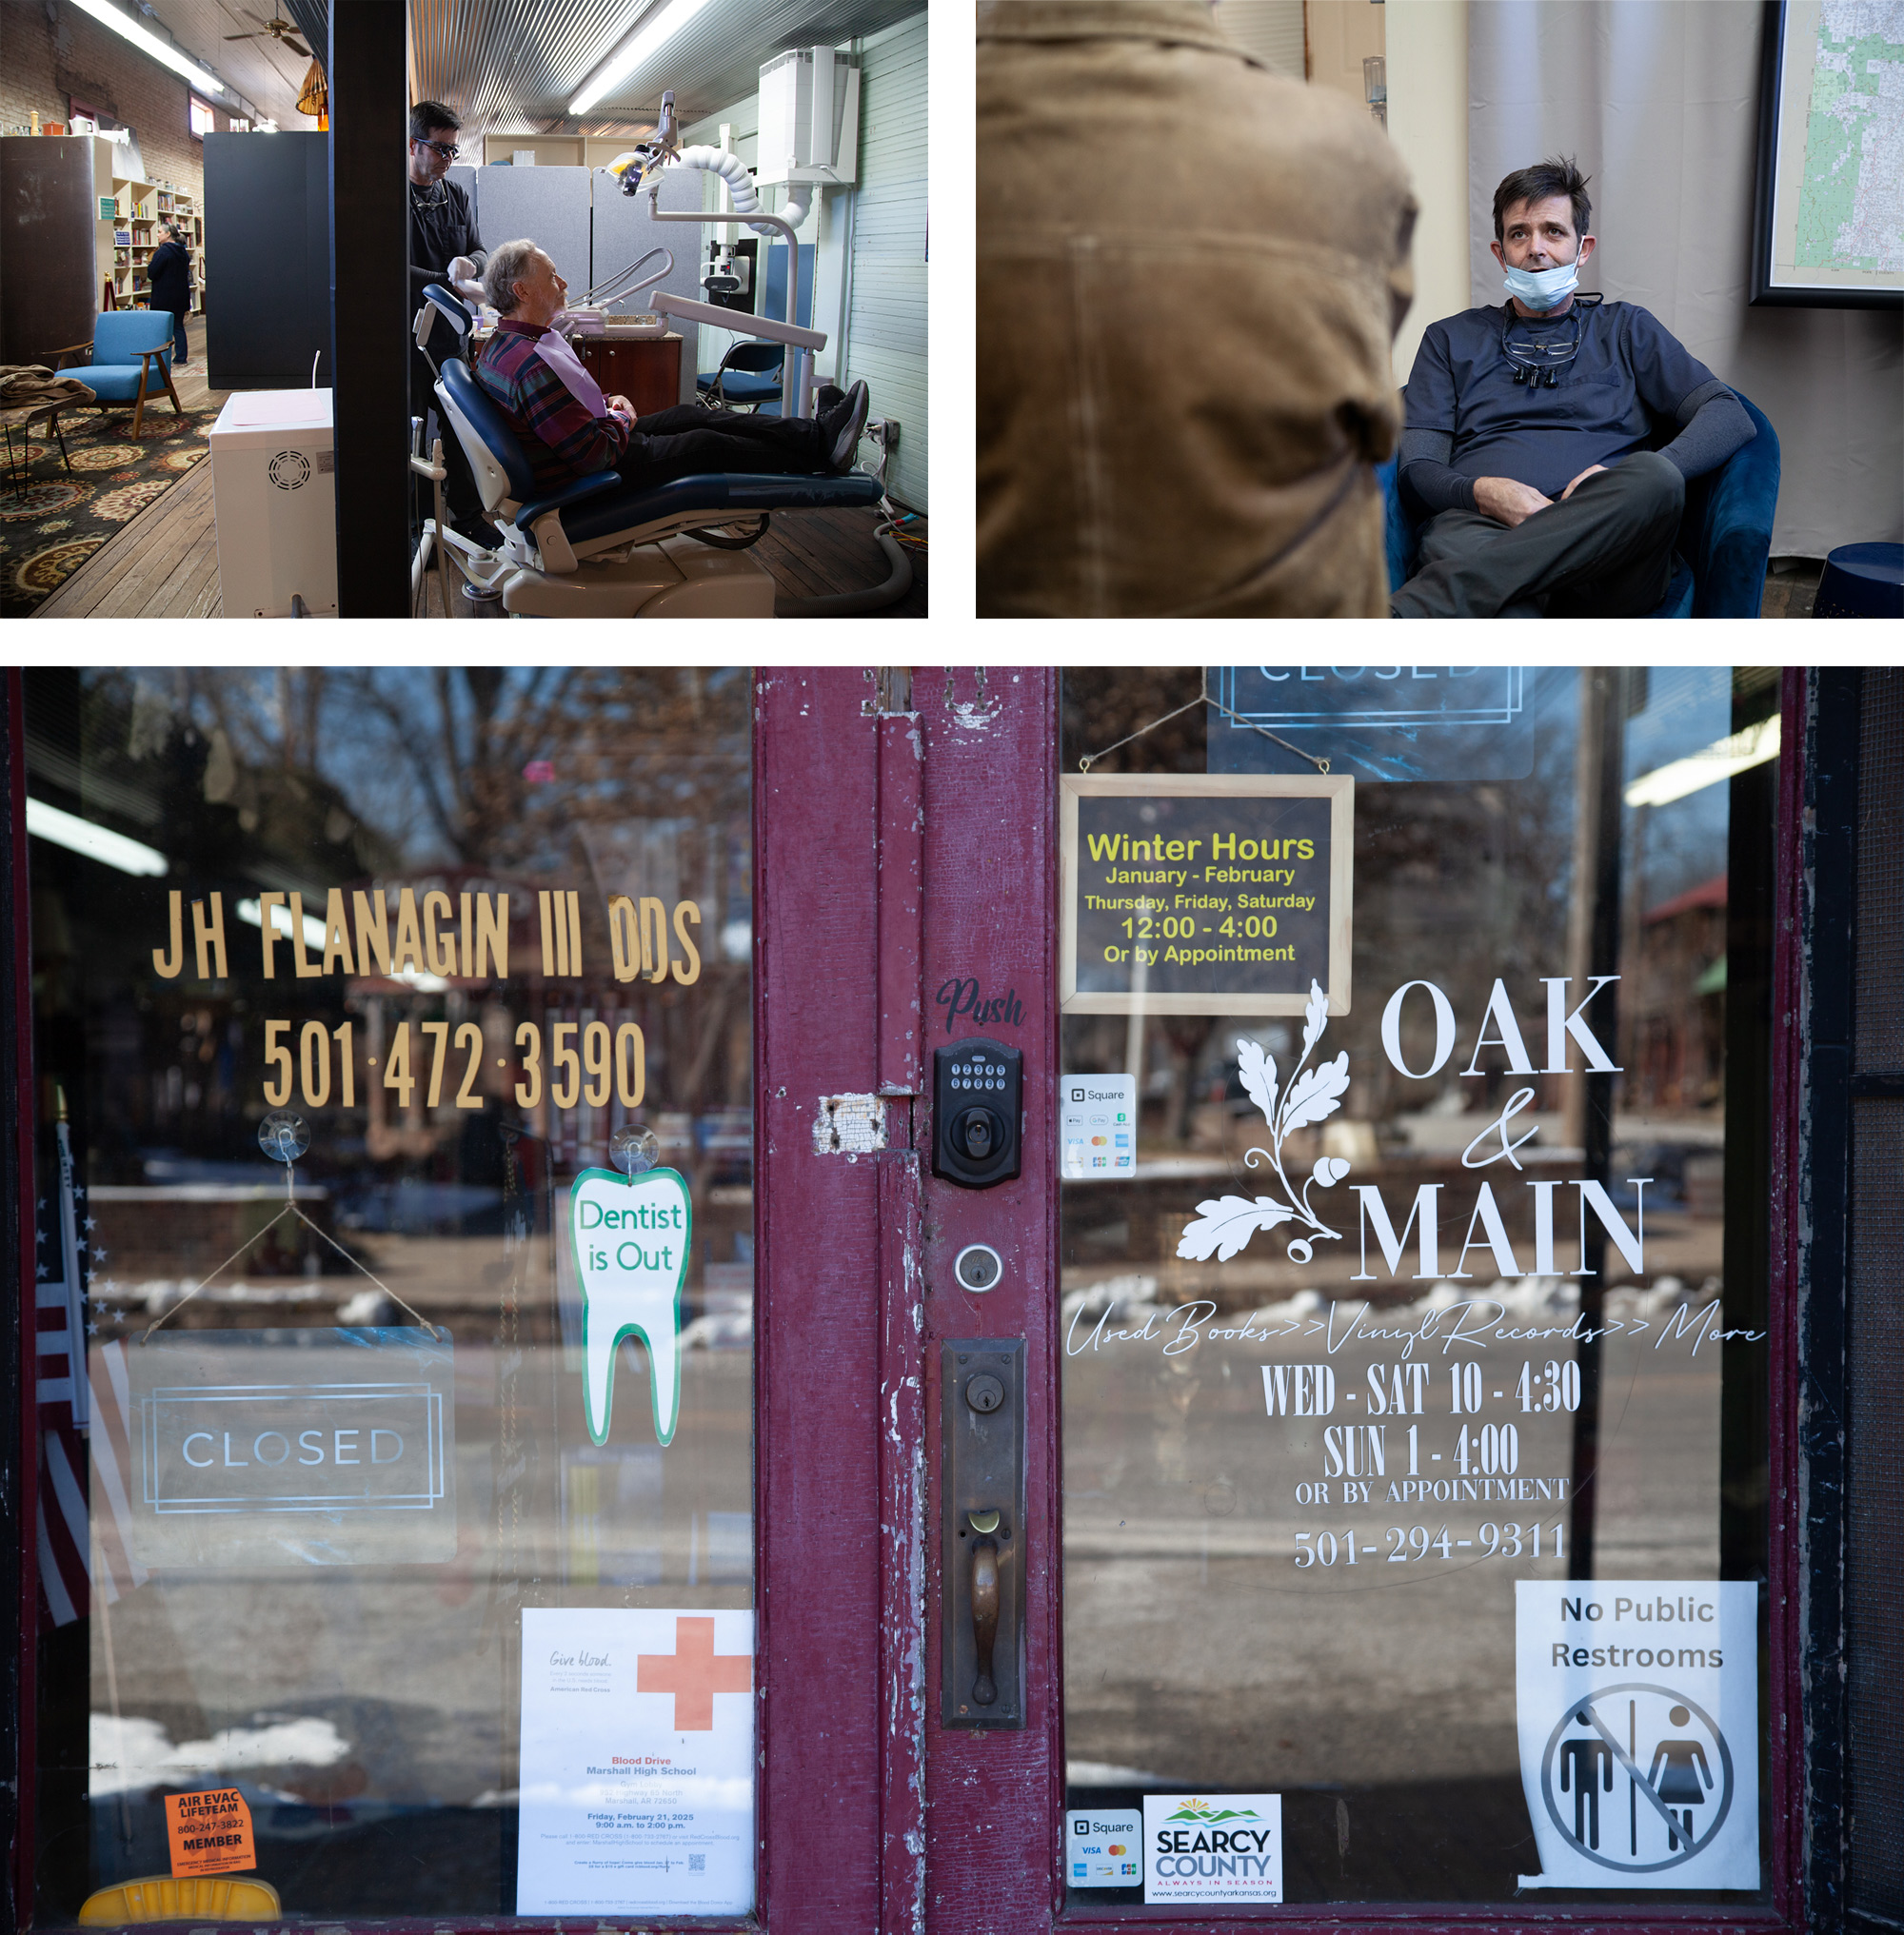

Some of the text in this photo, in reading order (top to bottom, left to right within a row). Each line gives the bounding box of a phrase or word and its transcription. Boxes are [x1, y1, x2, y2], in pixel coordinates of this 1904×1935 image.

[1087, 833, 1316, 861] Winter Hours
[1105, 866, 1188, 887] January
[1205, 865, 1295, 886] February
[1084, 894, 1316, 913] Thursday, Friday, Saturday
[152, 890, 228, 979] JH
[259, 887, 509, 979] FLANAGIN
[539, 890, 583, 978] III
[607, 894, 702, 986] DDS
[1121, 917, 1195, 939] 12:00
[1219, 916, 1278, 938] 4:00
[1103, 944, 1296, 966] Or by Appointment
[936, 977, 1027, 1035] Push
[1380, 975, 1624, 1080] OAK
[953, 1065, 958, 1074] 1
[964, 1065, 970, 1074] 2
[1088, 1091, 1124, 1101] Square
[1461, 1087, 1539, 1172] &
[579, 1200, 683, 1231] Dentist
[1349, 1178, 1654, 1280] MAIN
[588, 1242, 673, 1272] is Out
[1066, 1301, 1160, 1356] Used
[1655, 1298, 1766, 1356] More
[1261, 1364, 1336, 1417] WED
[1367, 1362, 1429, 1415] SAT
[1448, 1361, 1483, 1414] 10
[1515, 1359, 1581, 1414] 4:30
[181, 1429, 405, 1469] CLOSED
[1323, 1424, 1386, 1478] SUN
[1406, 1424, 1420, 1477] 1
[1453, 1423, 1519, 1476] 4:00
[1295, 1477, 1571, 1505] OR BY APPOINTMENT
[1560, 1596, 1715, 1622] No Public
[549, 1650, 612, 1667] Give blood.
[1552, 1643, 1723, 1668] Restrooms
[586, 1767, 697, 1776] Marshall High School
[612, 1756, 671, 1766] Blood Drive
[621, 1781, 663, 1789] Gym Lobby
[178, 1791, 239, 1808] AIR EVAC
[180, 1803, 238, 1818] LIFETEAM
[178, 1819, 244, 1834] 800-247-3822
[618, 1813, 654, 1822] February
[657, 1813, 670, 1822] 21,
[1093, 1823, 1134, 1835] Square
[184, 1834, 242, 1850] MEMBER
[1157, 1829, 1271, 1853] SEARCY
[1156, 1855, 1271, 1878] COUNTY
[1152, 1888, 1277, 1898] www.searcycountyarkansas.org
